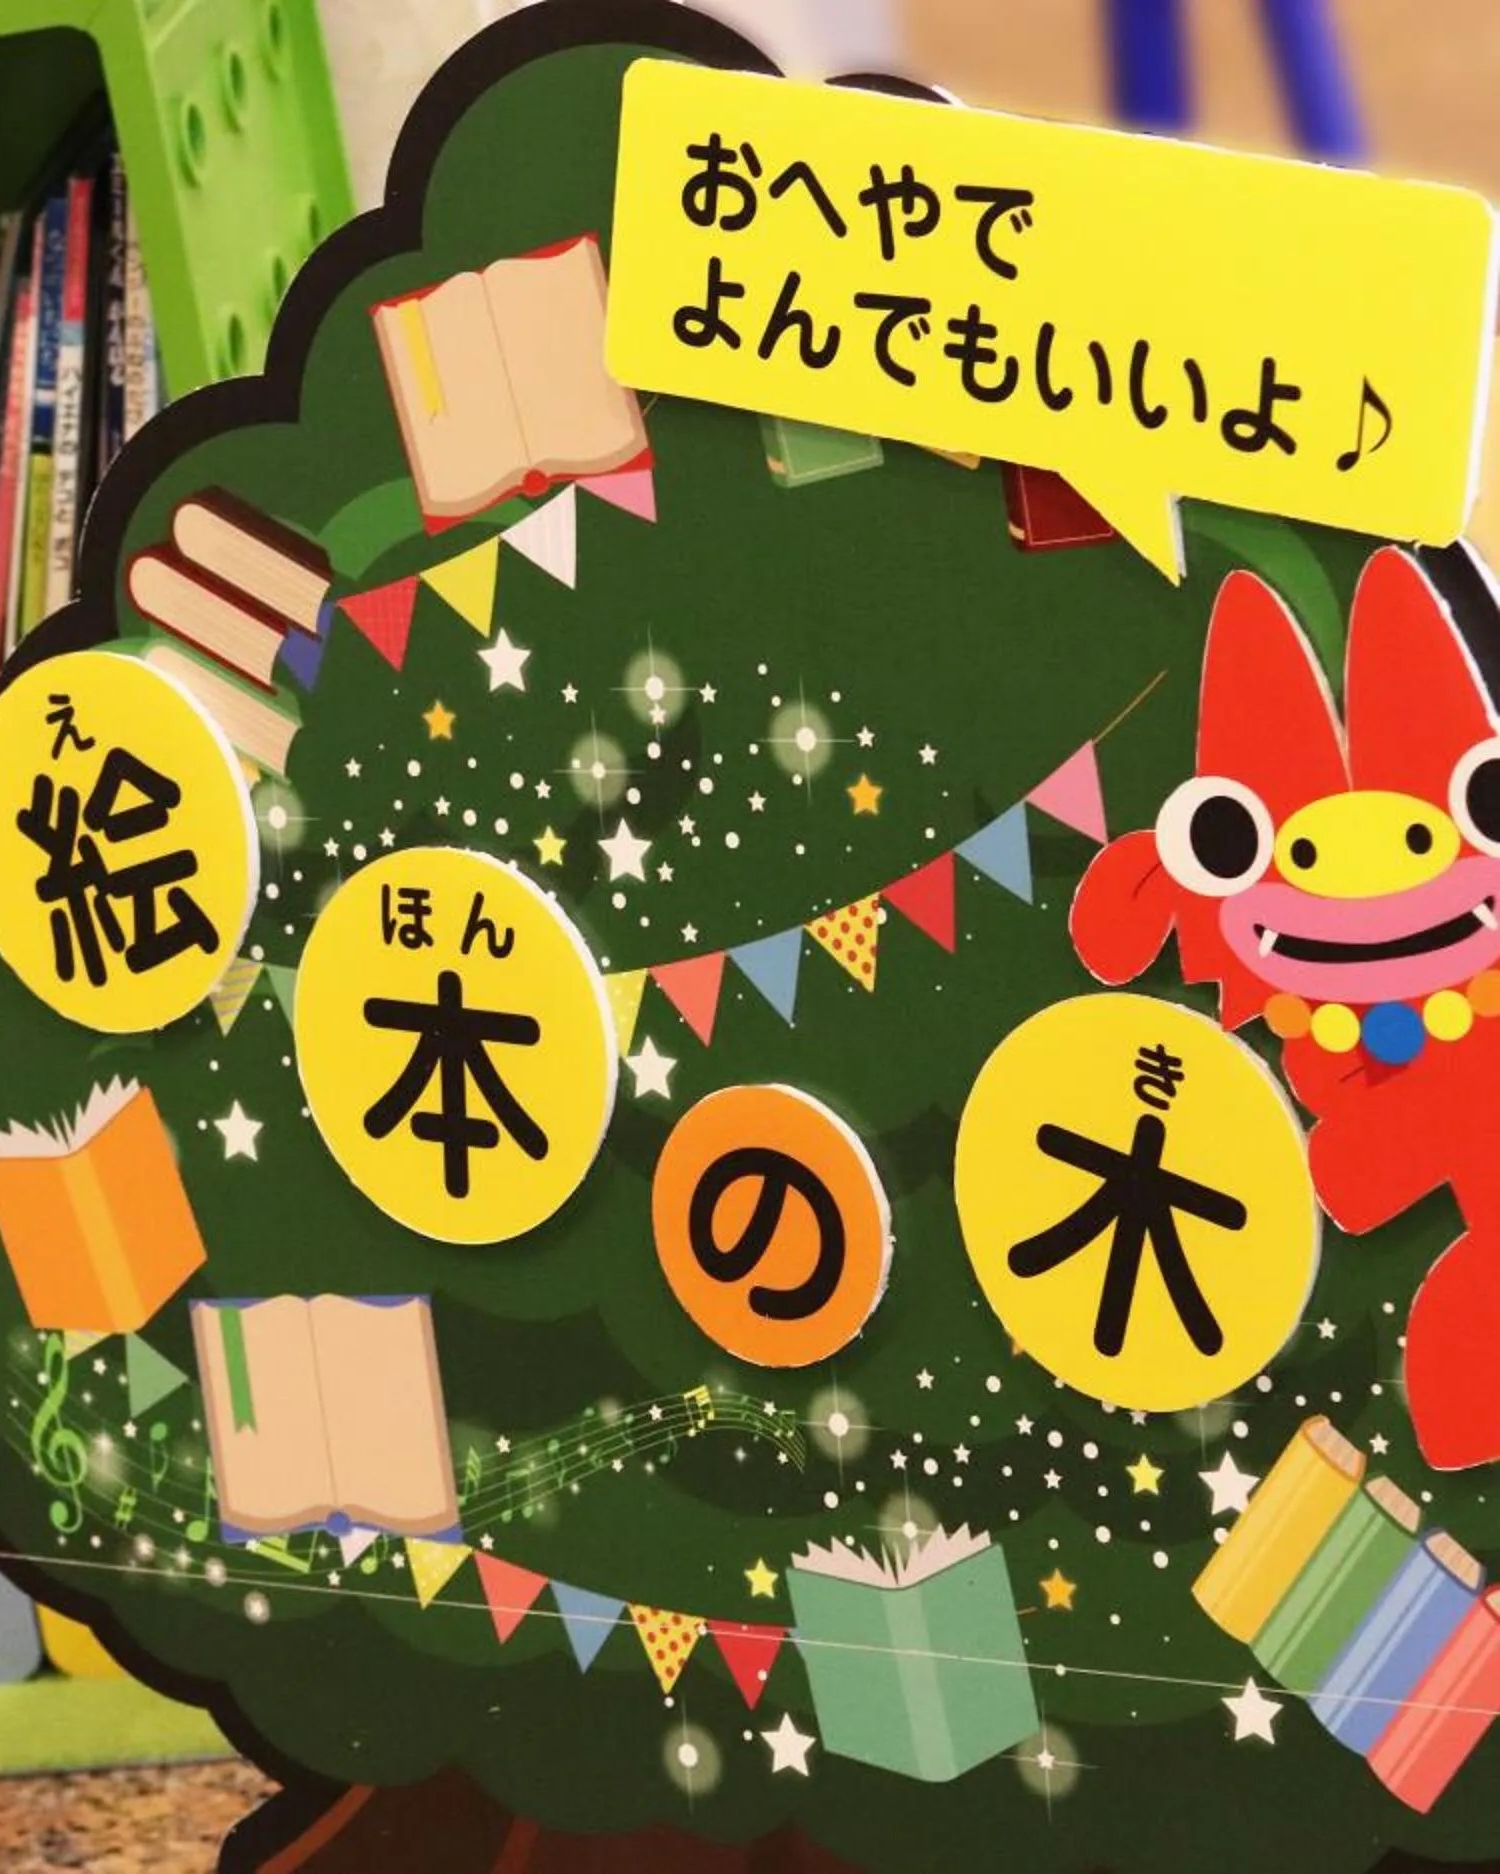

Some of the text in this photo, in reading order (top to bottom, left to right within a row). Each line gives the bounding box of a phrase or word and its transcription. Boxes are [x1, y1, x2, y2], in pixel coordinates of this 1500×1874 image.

[681, 132, 1034, 280] おへやで
[15, 747, 1248, 1358] 絵 本 の 木
[45, 694, 1185, 1111] え ほん き
